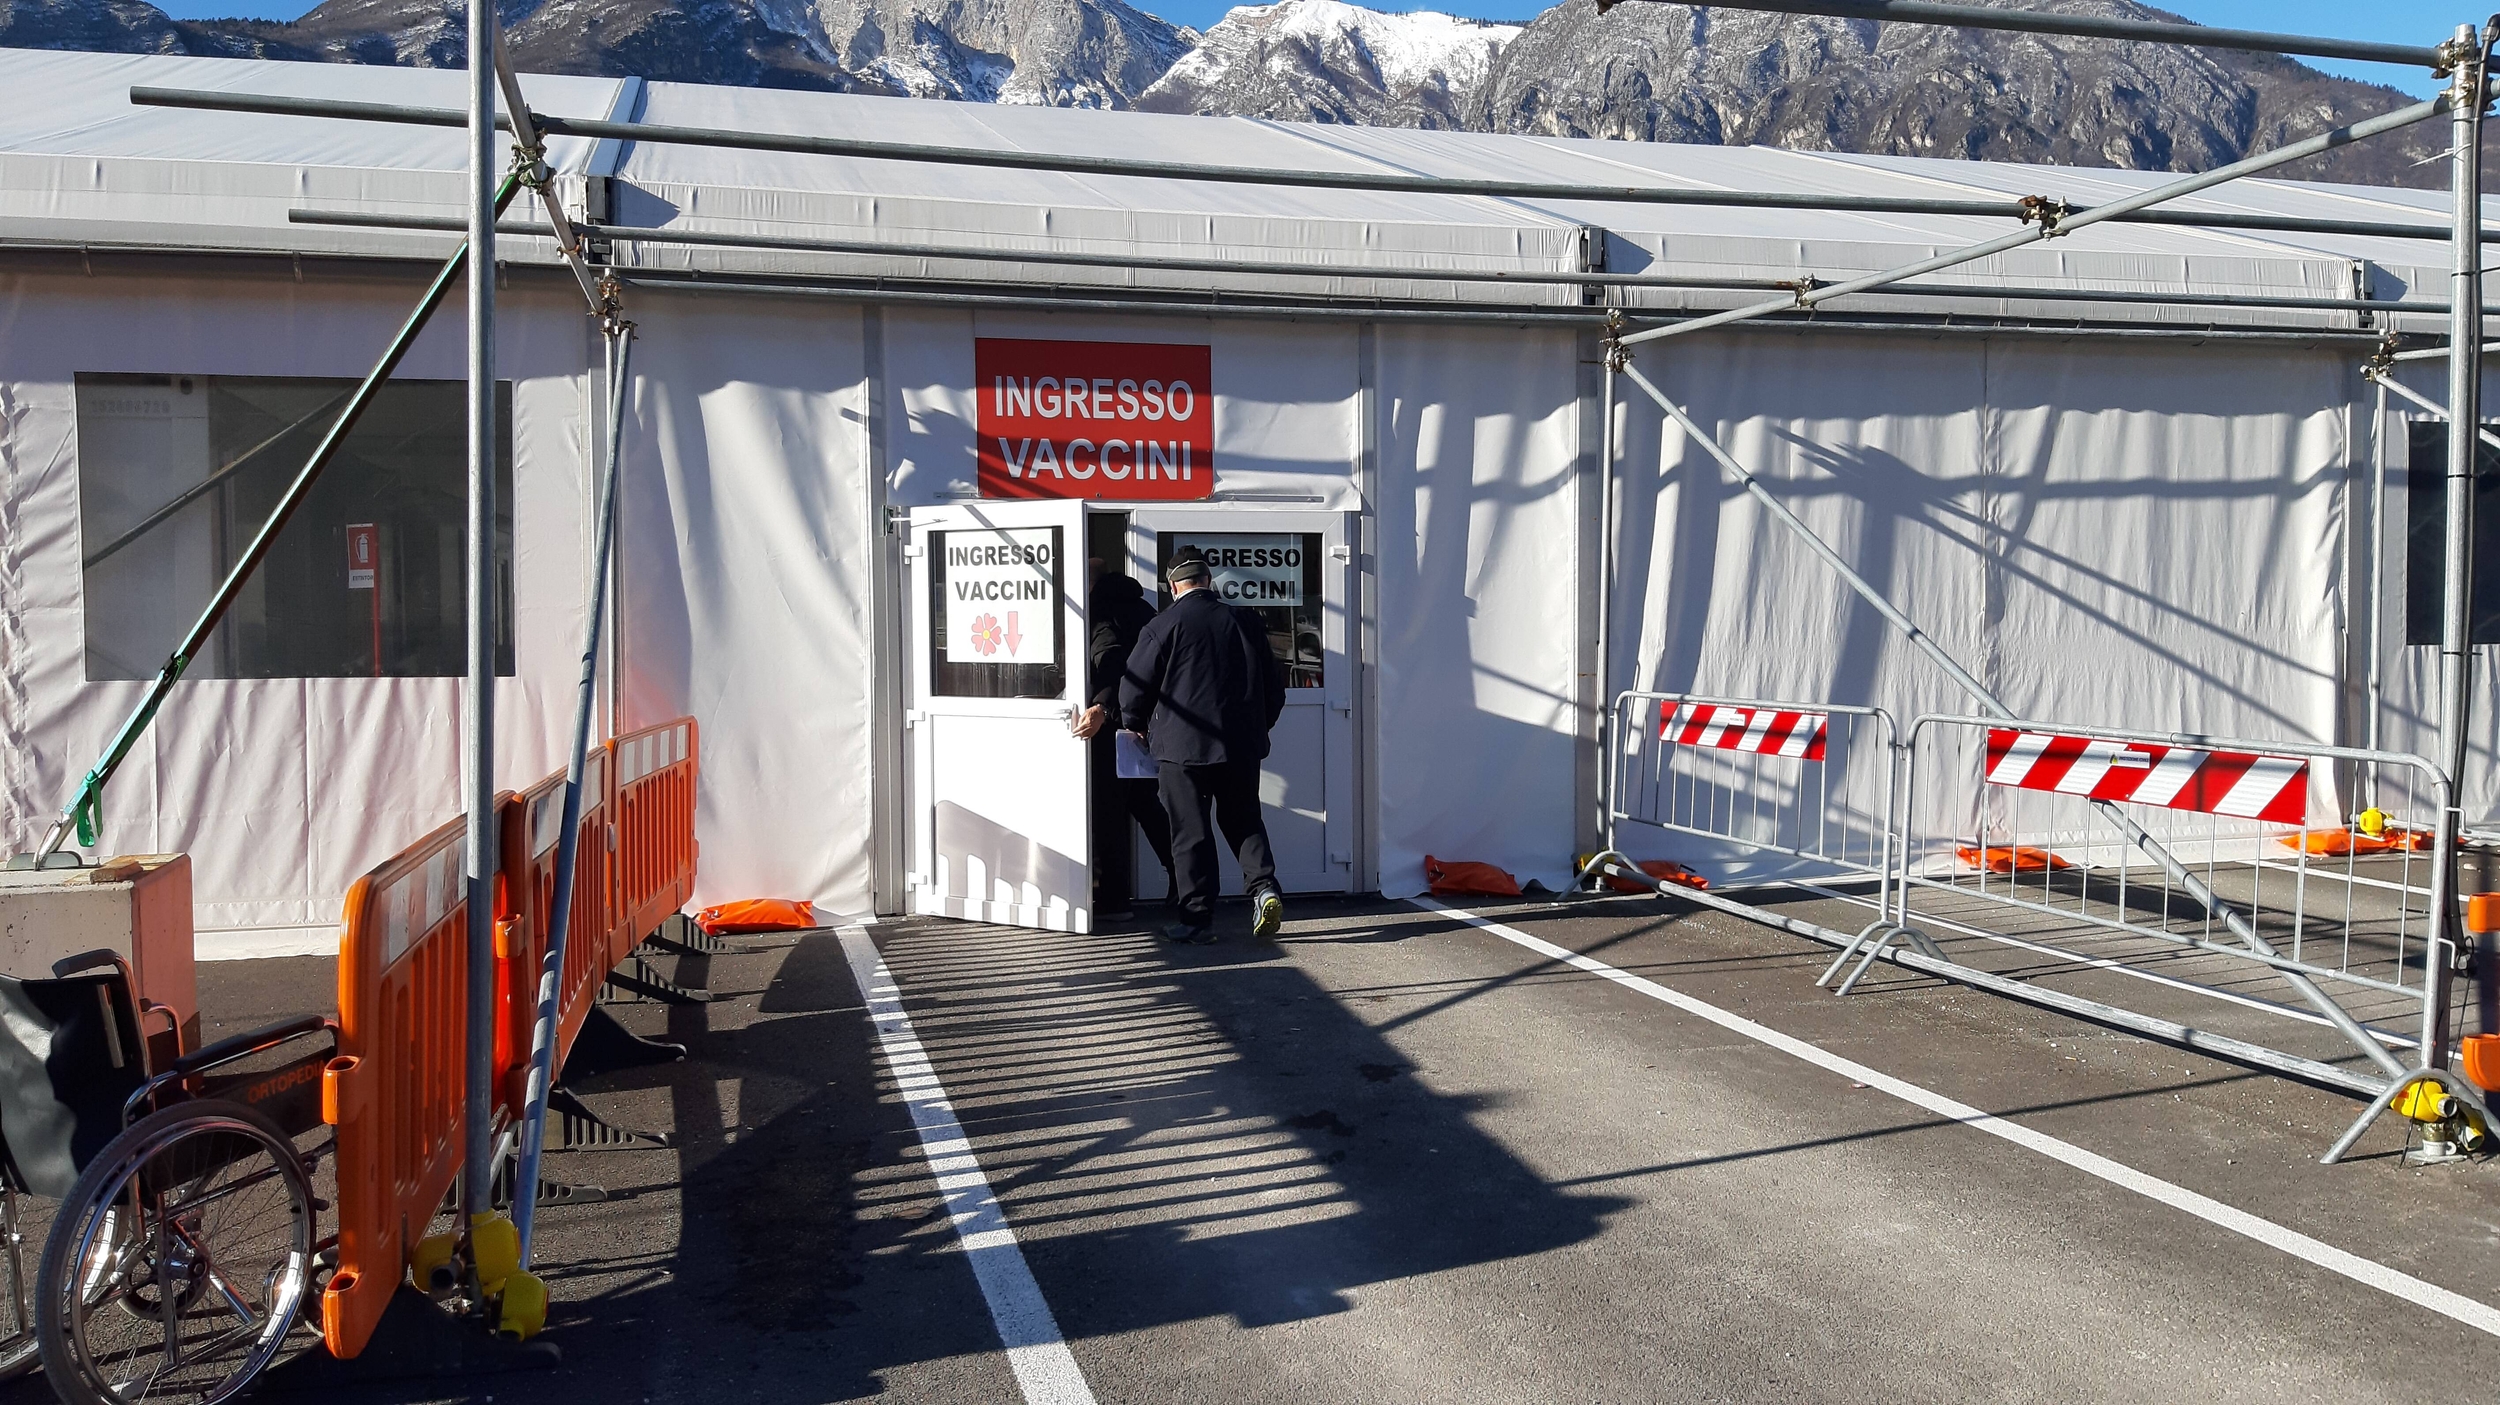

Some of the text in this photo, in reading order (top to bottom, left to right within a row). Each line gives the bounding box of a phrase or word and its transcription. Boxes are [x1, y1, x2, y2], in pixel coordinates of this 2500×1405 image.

[995, 375, 1194, 421] INGRESSO
[997, 437, 1193, 481] VACCINI
[949, 544, 1050, 566] INGRESSO
[1203, 548, 1301, 568] GRESSO
[955, 580, 1046, 601] VACCINI
[1210, 580, 1296, 600] ACCINI
